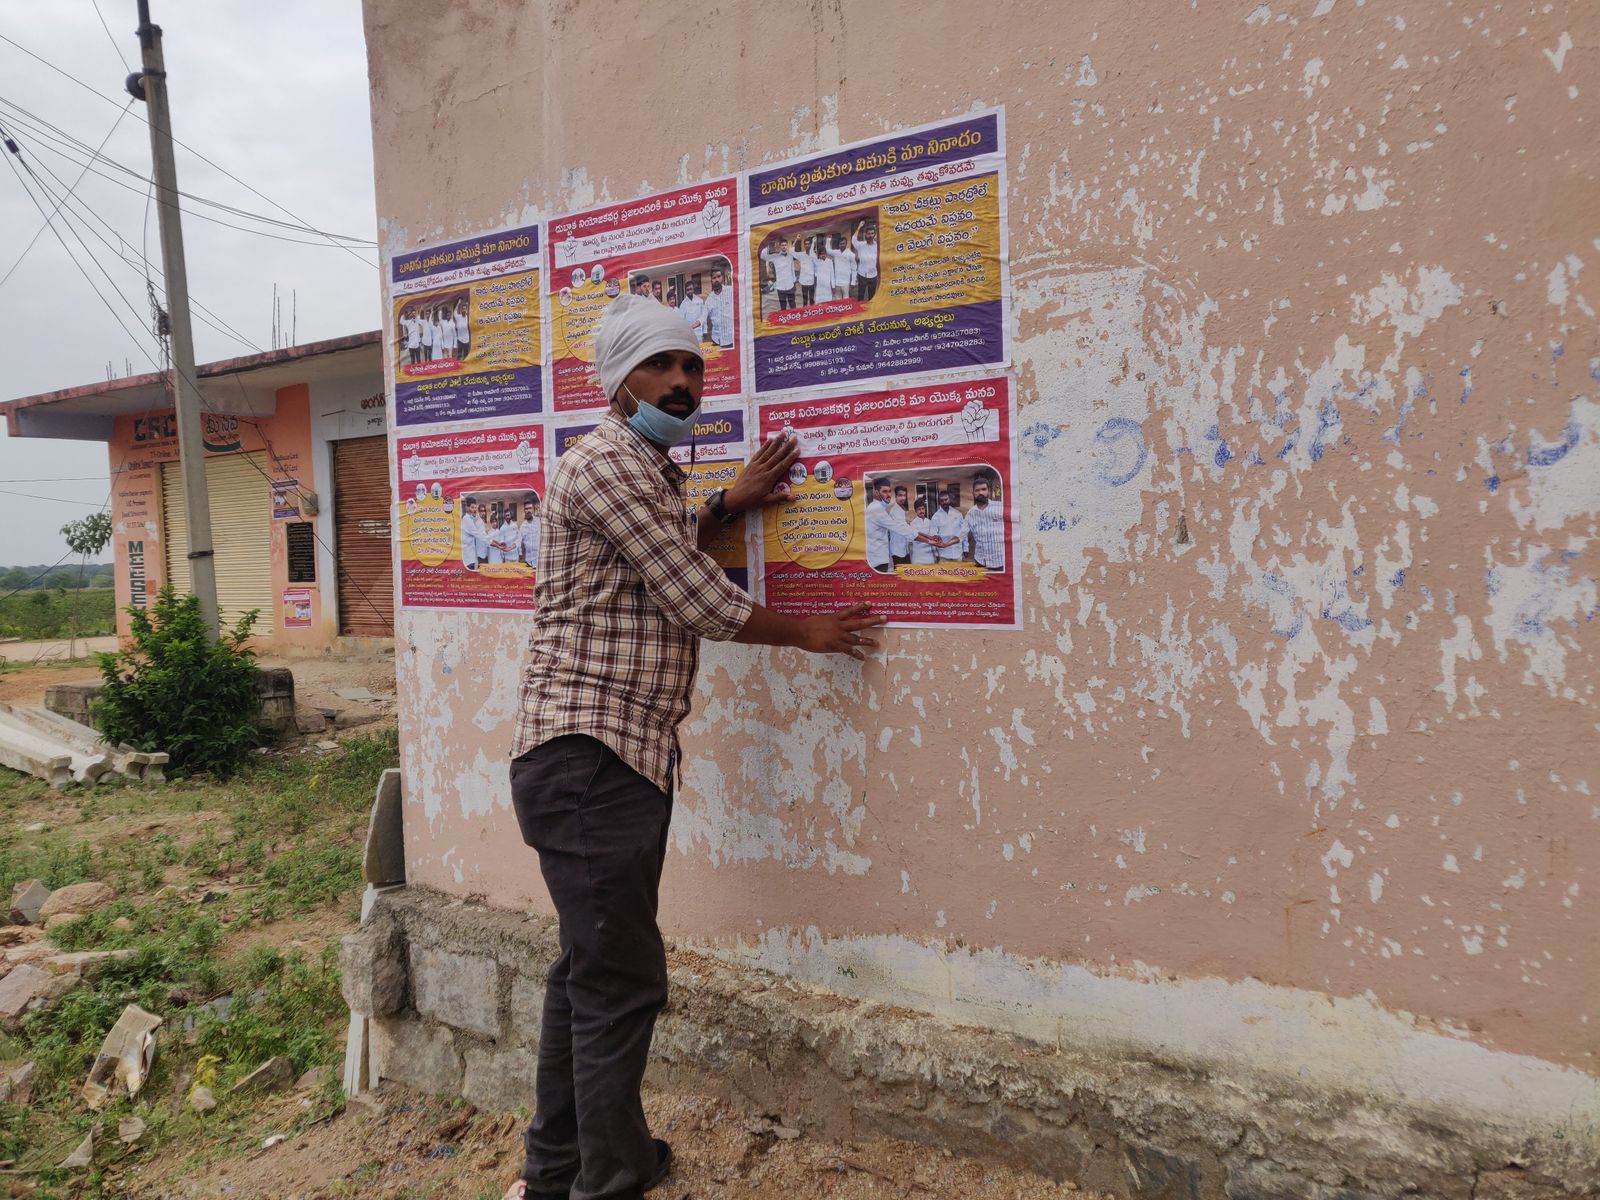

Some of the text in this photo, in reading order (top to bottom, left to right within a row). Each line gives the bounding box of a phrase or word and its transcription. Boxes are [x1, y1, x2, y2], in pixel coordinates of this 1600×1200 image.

[761, 129, 982, 195] బానిస బ్రతుకుల విముక్తి మా నినాదం
[663, 198, 678, 209] మా
[704, 185, 728, 199] మనవి
[767, 205, 784, 216] ఓటు
[836, 184, 858, 199] అంటే
[860, 185, 867, 195] నీ
[889, 176, 914, 188] నువ్వు
[895, 213, 938, 233] ఉదయమే
[482, 243, 496, 254] మా
[498, 235, 530, 252] నినాదం
[896, 243, 904, 252] ఆ
[907, 233, 935, 251] వెలుగే
[818, 326, 842, 342] బరిలో
[844, 323, 865, 337] పోటీ
[768, 408, 796, 426] దుబ్బాక
[798, 402, 851, 419] నియోజకవర్గ
[909, 394, 926, 406] మా
[929, 390, 962, 403] యొక్క
[965, 386, 996, 400] మనవి
[906, 419, 917, 429] మీ
[918, 415, 954, 427] అడుగులే
[817, 444, 827, 452] ఈ
[911, 433, 939, 443] కావాలి
[128, 541, 147, 610] MEESE
